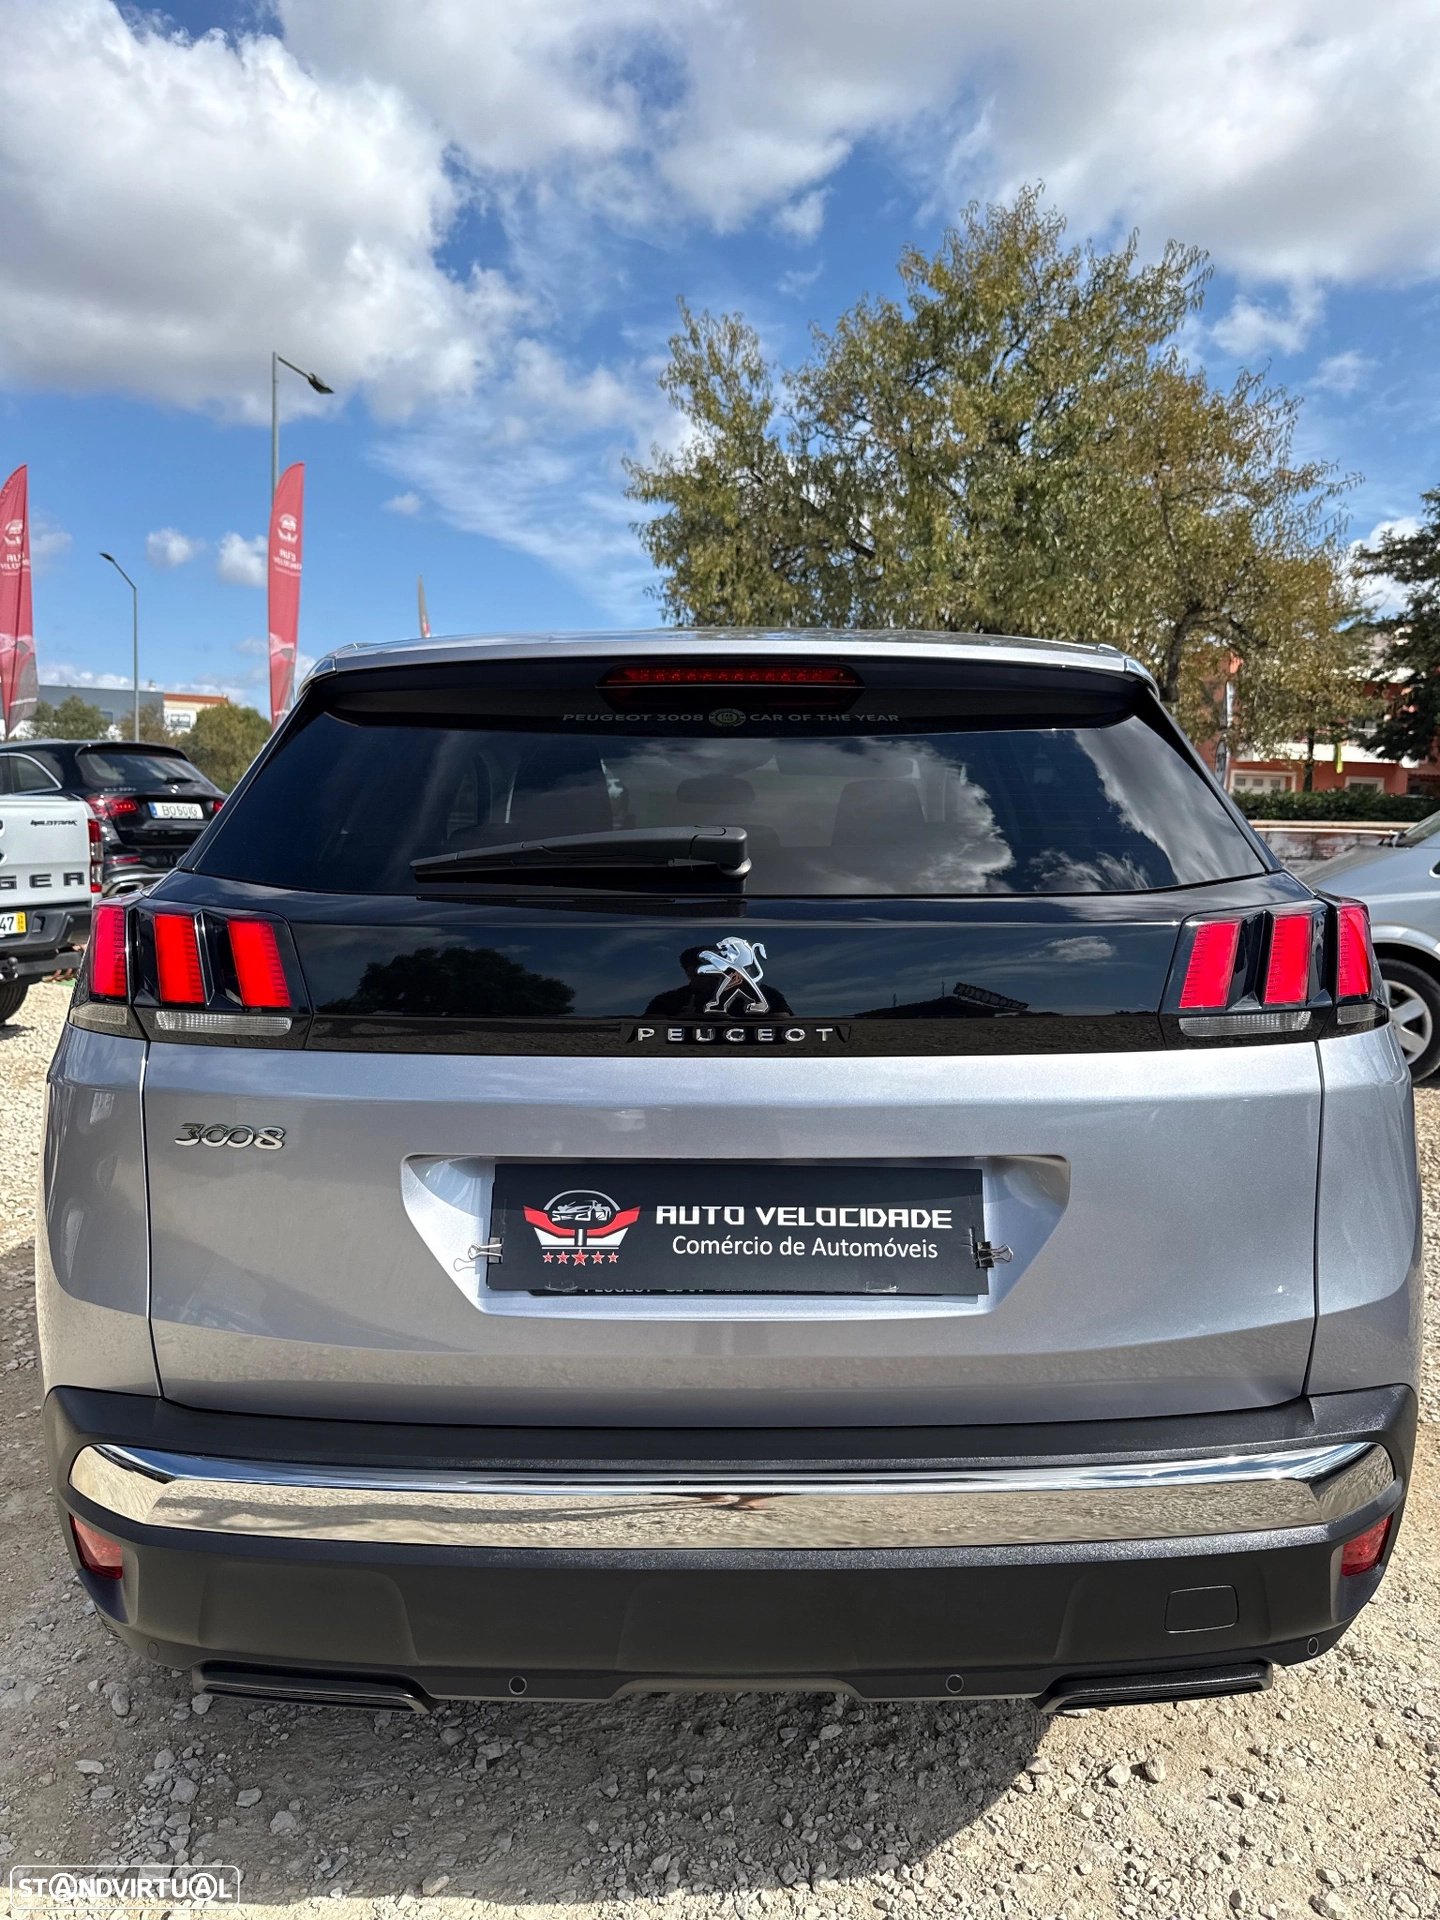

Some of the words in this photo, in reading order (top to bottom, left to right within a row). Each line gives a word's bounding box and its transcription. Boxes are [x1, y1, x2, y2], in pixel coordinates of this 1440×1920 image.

[562, 713, 652, 722] PEUGEOT
[656, 713, 704, 722] 3008
[749, 713, 783, 722] CAR
[788, 713, 812, 722] OF
[816, 713, 851, 722] THE
[855, 714, 899, 722] YEAR
[637, 1028, 834, 1042] PEUGEOT
[174, 1122, 286, 1150] 3008
[656, 1205, 745, 1226] AUTO
[755, 1206, 953, 1229] VELOCIDADE
[672, 1234, 773, 1256] Comércio
[779, 1236, 806, 1256] de
[811, 1237, 939, 1259] Automóveis
